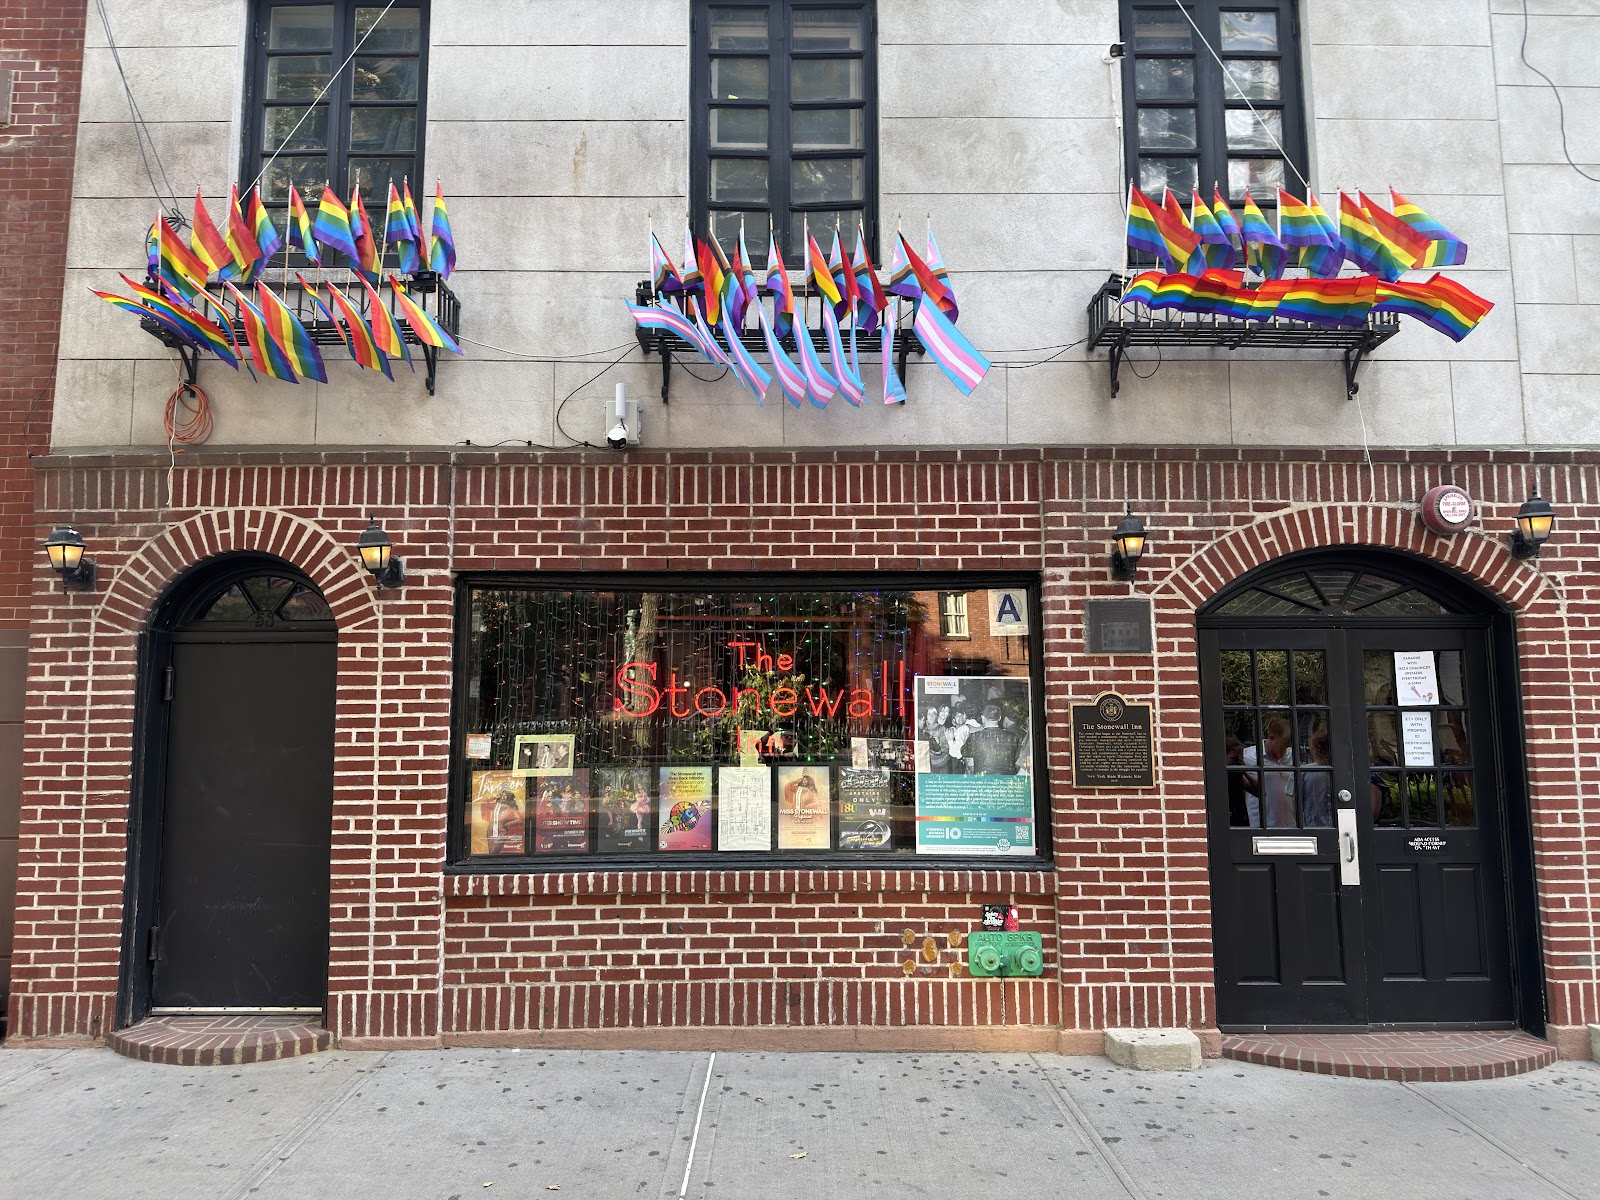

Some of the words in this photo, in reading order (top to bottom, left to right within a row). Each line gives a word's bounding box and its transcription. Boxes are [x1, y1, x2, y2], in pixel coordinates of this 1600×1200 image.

[1443, 493, 1464, 502] SPRINKLER
[996, 594, 1021, 622] A
[256, 612, 274, 628] 53
[728, 641, 793, 672] The
[613, 659, 905, 719] Stonewall
[1096, 723, 1129, 731] Stonewall
[1131, 723, 1142, 731] Inn
[736, 725, 784, 755] Inn
[978, 932, 1003, 942] AUTO
[1007, 932, 1034, 942] SPKR
